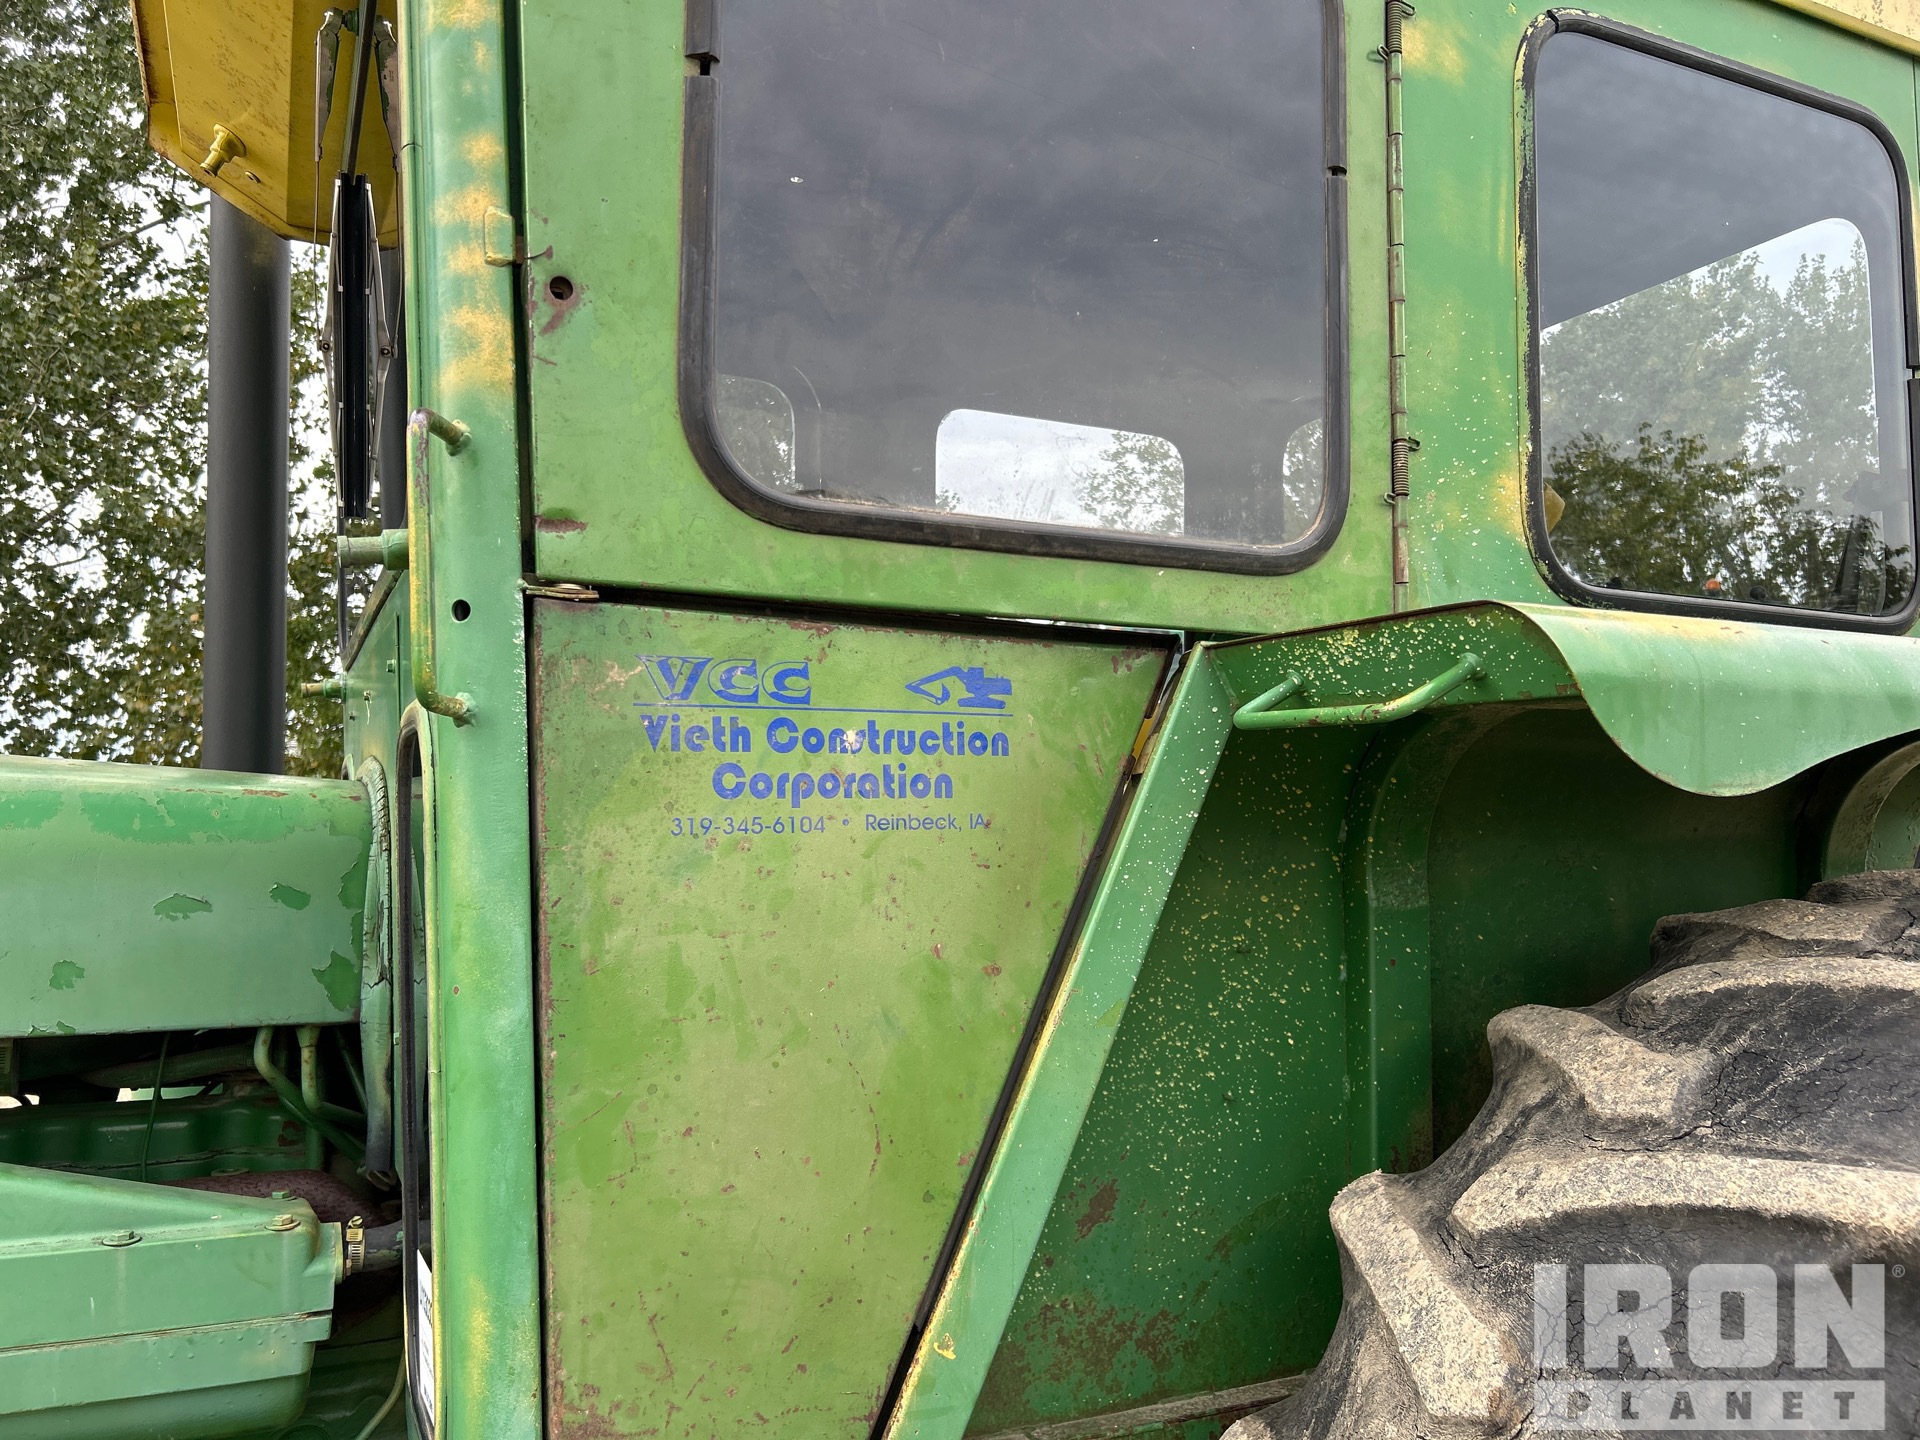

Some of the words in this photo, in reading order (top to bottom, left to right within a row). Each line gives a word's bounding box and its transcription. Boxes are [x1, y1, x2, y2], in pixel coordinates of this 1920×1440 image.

[634, 654, 812, 706] VCC
[639, 714, 752, 753] Vieth
[766, 717, 1010, 757] Construction
[712, 762, 953, 808] Corporation
[670, 816, 826, 836] 319-345-6104
[865, 813, 963, 833] Reinbeck,
